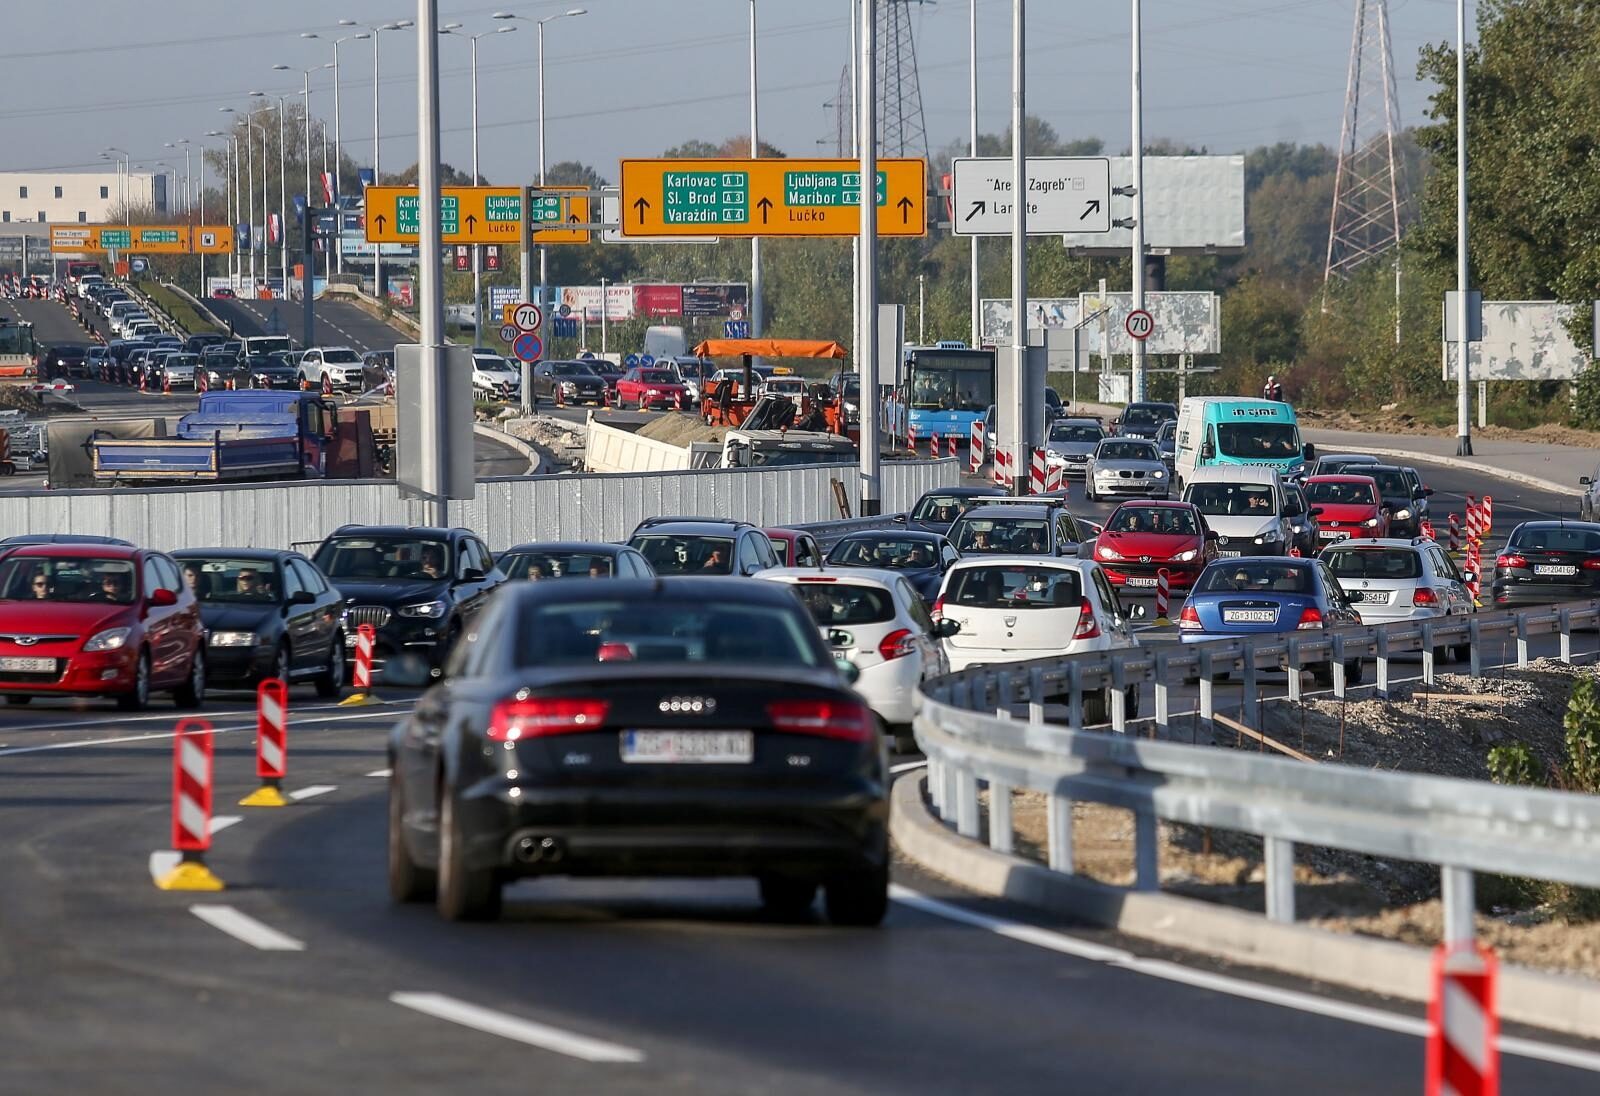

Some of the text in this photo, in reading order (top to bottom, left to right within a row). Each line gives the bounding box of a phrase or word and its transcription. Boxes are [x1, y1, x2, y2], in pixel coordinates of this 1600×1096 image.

[667, 174, 717, 187] Karlovac
[789, 174, 837, 190] Ljubljana
[668, 192, 681, 204] Sl.
[689, 192, 716, 204] Brod
[789, 191, 836, 204] Maribor
[488, 198, 521, 210] Ljubljan
[488, 210, 520, 221] Maribo
[668, 208, 717, 222] Varaždin
[608, 289, 630, 297] EXPO
[520, 311, 536, 325] 70
[1132, 317, 1149, 332] 70
[503, 328, 515, 339] 70
[1232, 408, 1245, 416] in
[1242, 461, 1288, 469] express
[1230, 611, 1240, 620] ZG
